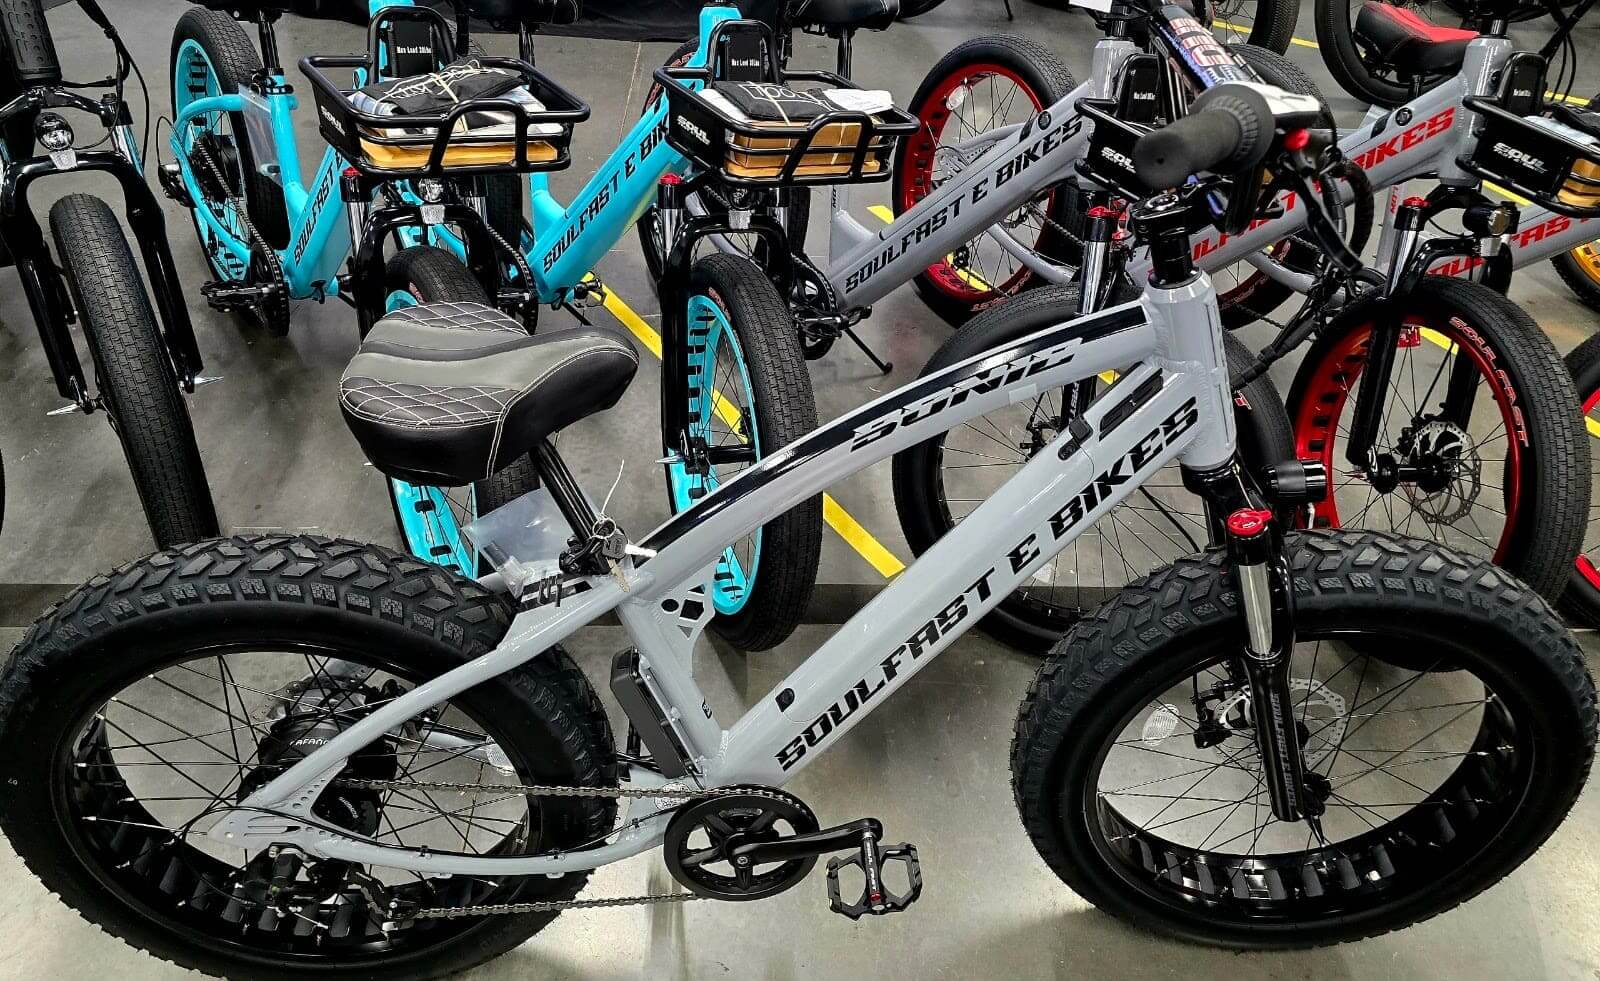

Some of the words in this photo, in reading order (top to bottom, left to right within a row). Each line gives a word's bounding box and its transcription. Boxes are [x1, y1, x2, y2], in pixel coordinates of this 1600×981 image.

[543, 170, 620, 273] SOULFAST
[624, 152, 635, 179] E
[640, 113, 669, 162] BIK
[677, 115, 710, 145] SOUL
[1494, 143, 1546, 171] SOUL
[294, 161, 334, 266] SOULFAST
[845, 194, 966, 294] SOULFAST
[972, 178, 988, 204] E
[996, 114, 1082, 188] BIKES
[775, 567, 994, 771] SOULFAST
[1006, 533, 1040, 574] E
[1047, 396, 1199, 540] BIKES
